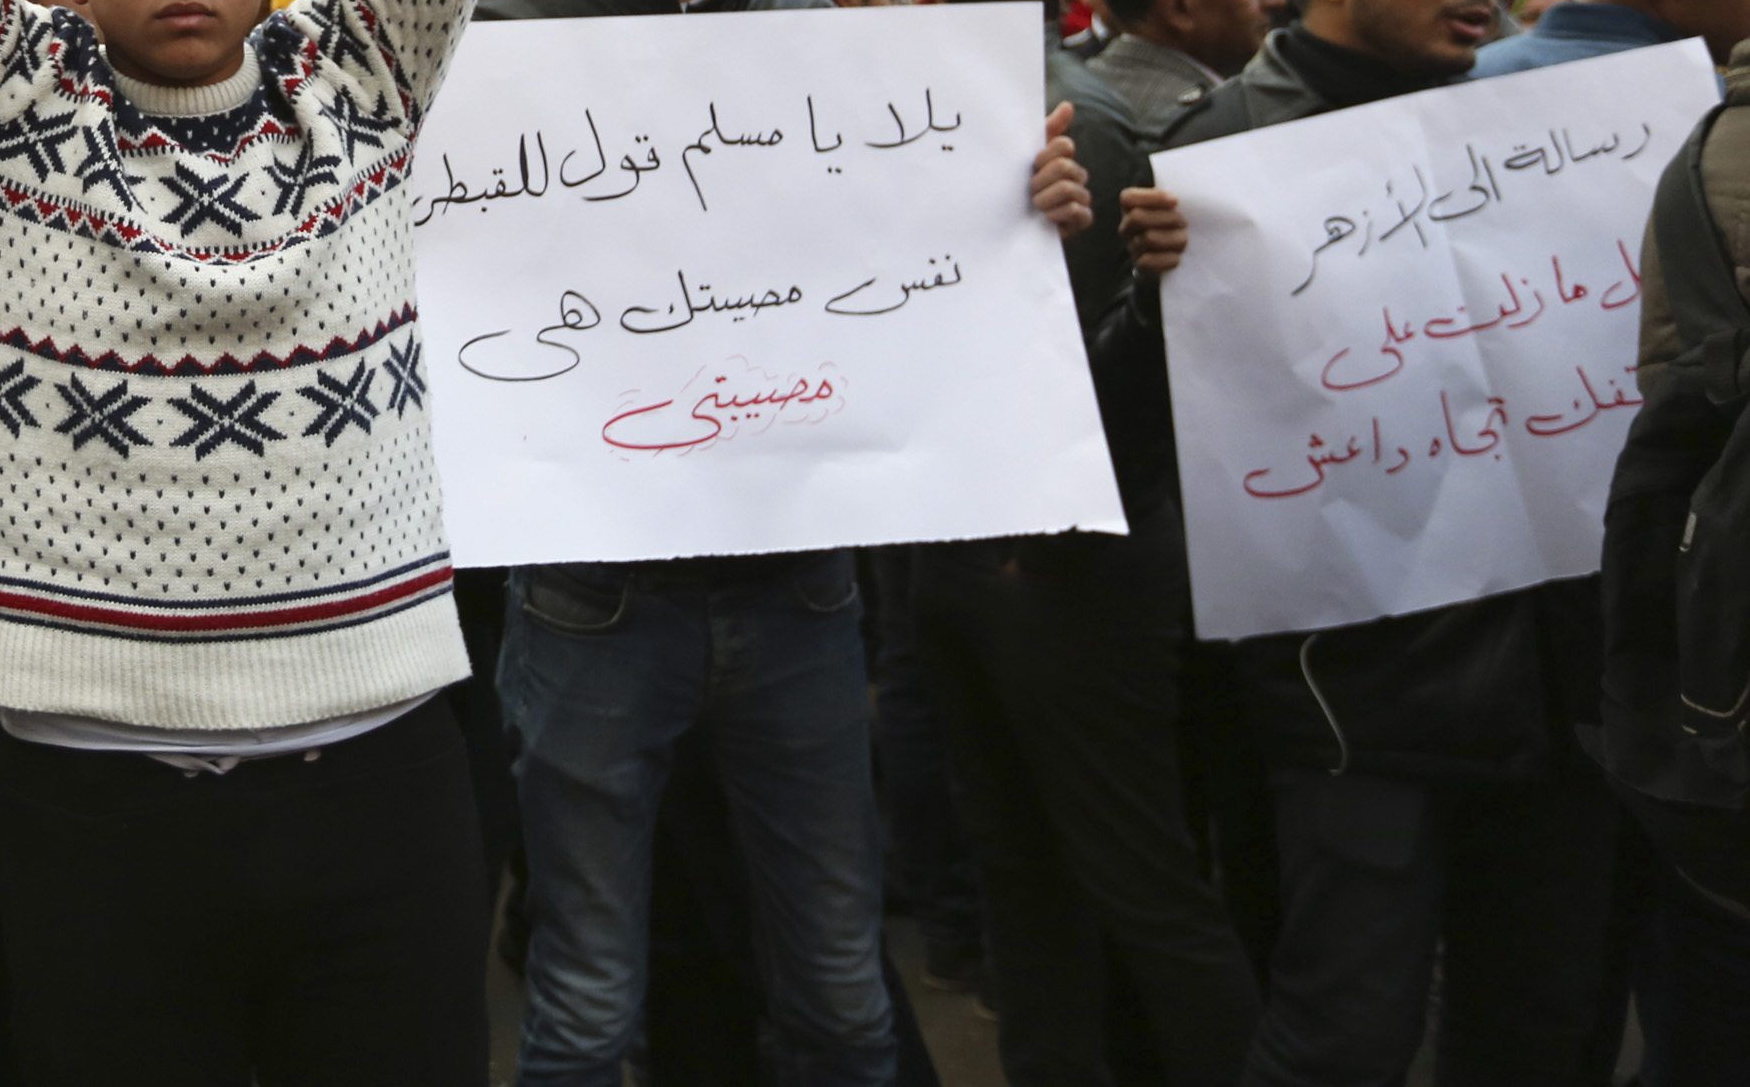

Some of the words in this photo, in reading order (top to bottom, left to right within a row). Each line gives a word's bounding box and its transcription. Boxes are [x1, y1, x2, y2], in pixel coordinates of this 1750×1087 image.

[560, 109, 660, 202] قول
[682, 102, 783, 211] مسلم
[807, 95, 842, 174] يا
[866, 88, 961, 151] يلا
[1504, 125, 1650, 175] رسالة
[1292, 166, 1425, 295] الأزهر
[825, 255, 961, 315] نفس
[1245, 420, 1408, 498] داعش
[1430, 394, 1507, 461] تجاه
